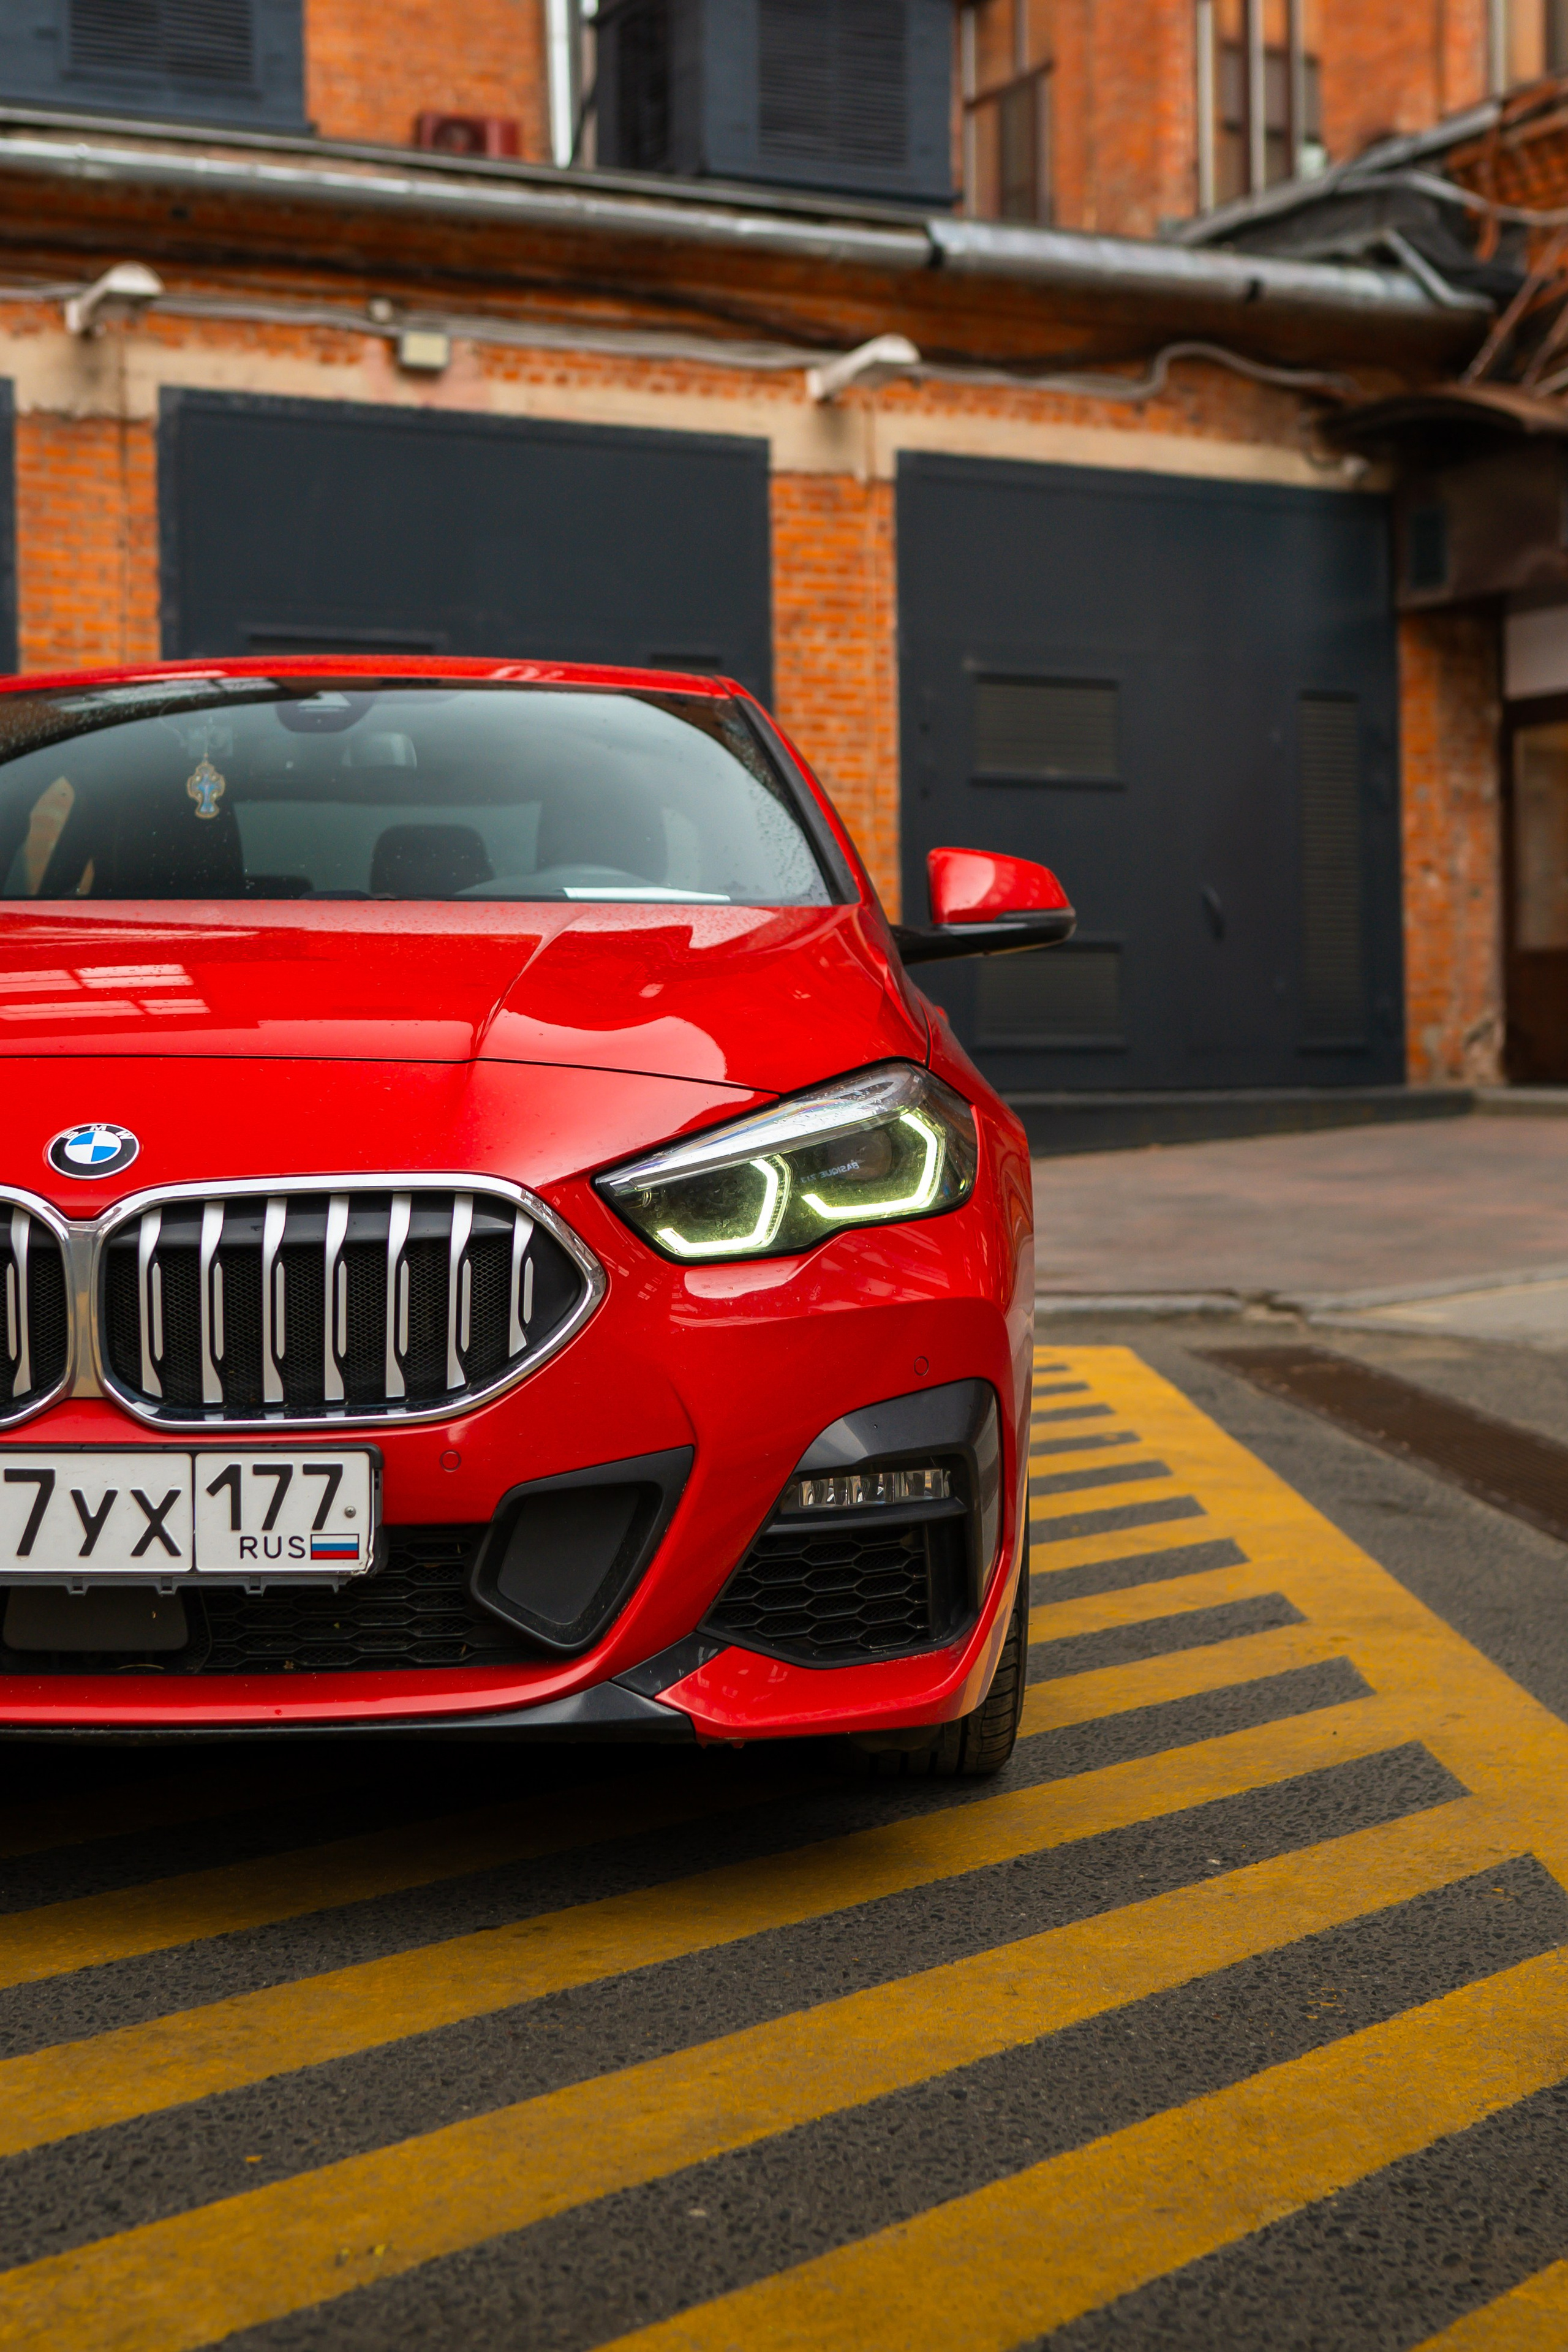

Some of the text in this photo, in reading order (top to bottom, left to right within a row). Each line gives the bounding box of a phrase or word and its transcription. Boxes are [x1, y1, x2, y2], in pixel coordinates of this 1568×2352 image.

[61, 1125, 134, 1140] BMW
[206, 1464, 344, 1531] 177
[239, 1536, 306, 1559] RUS
